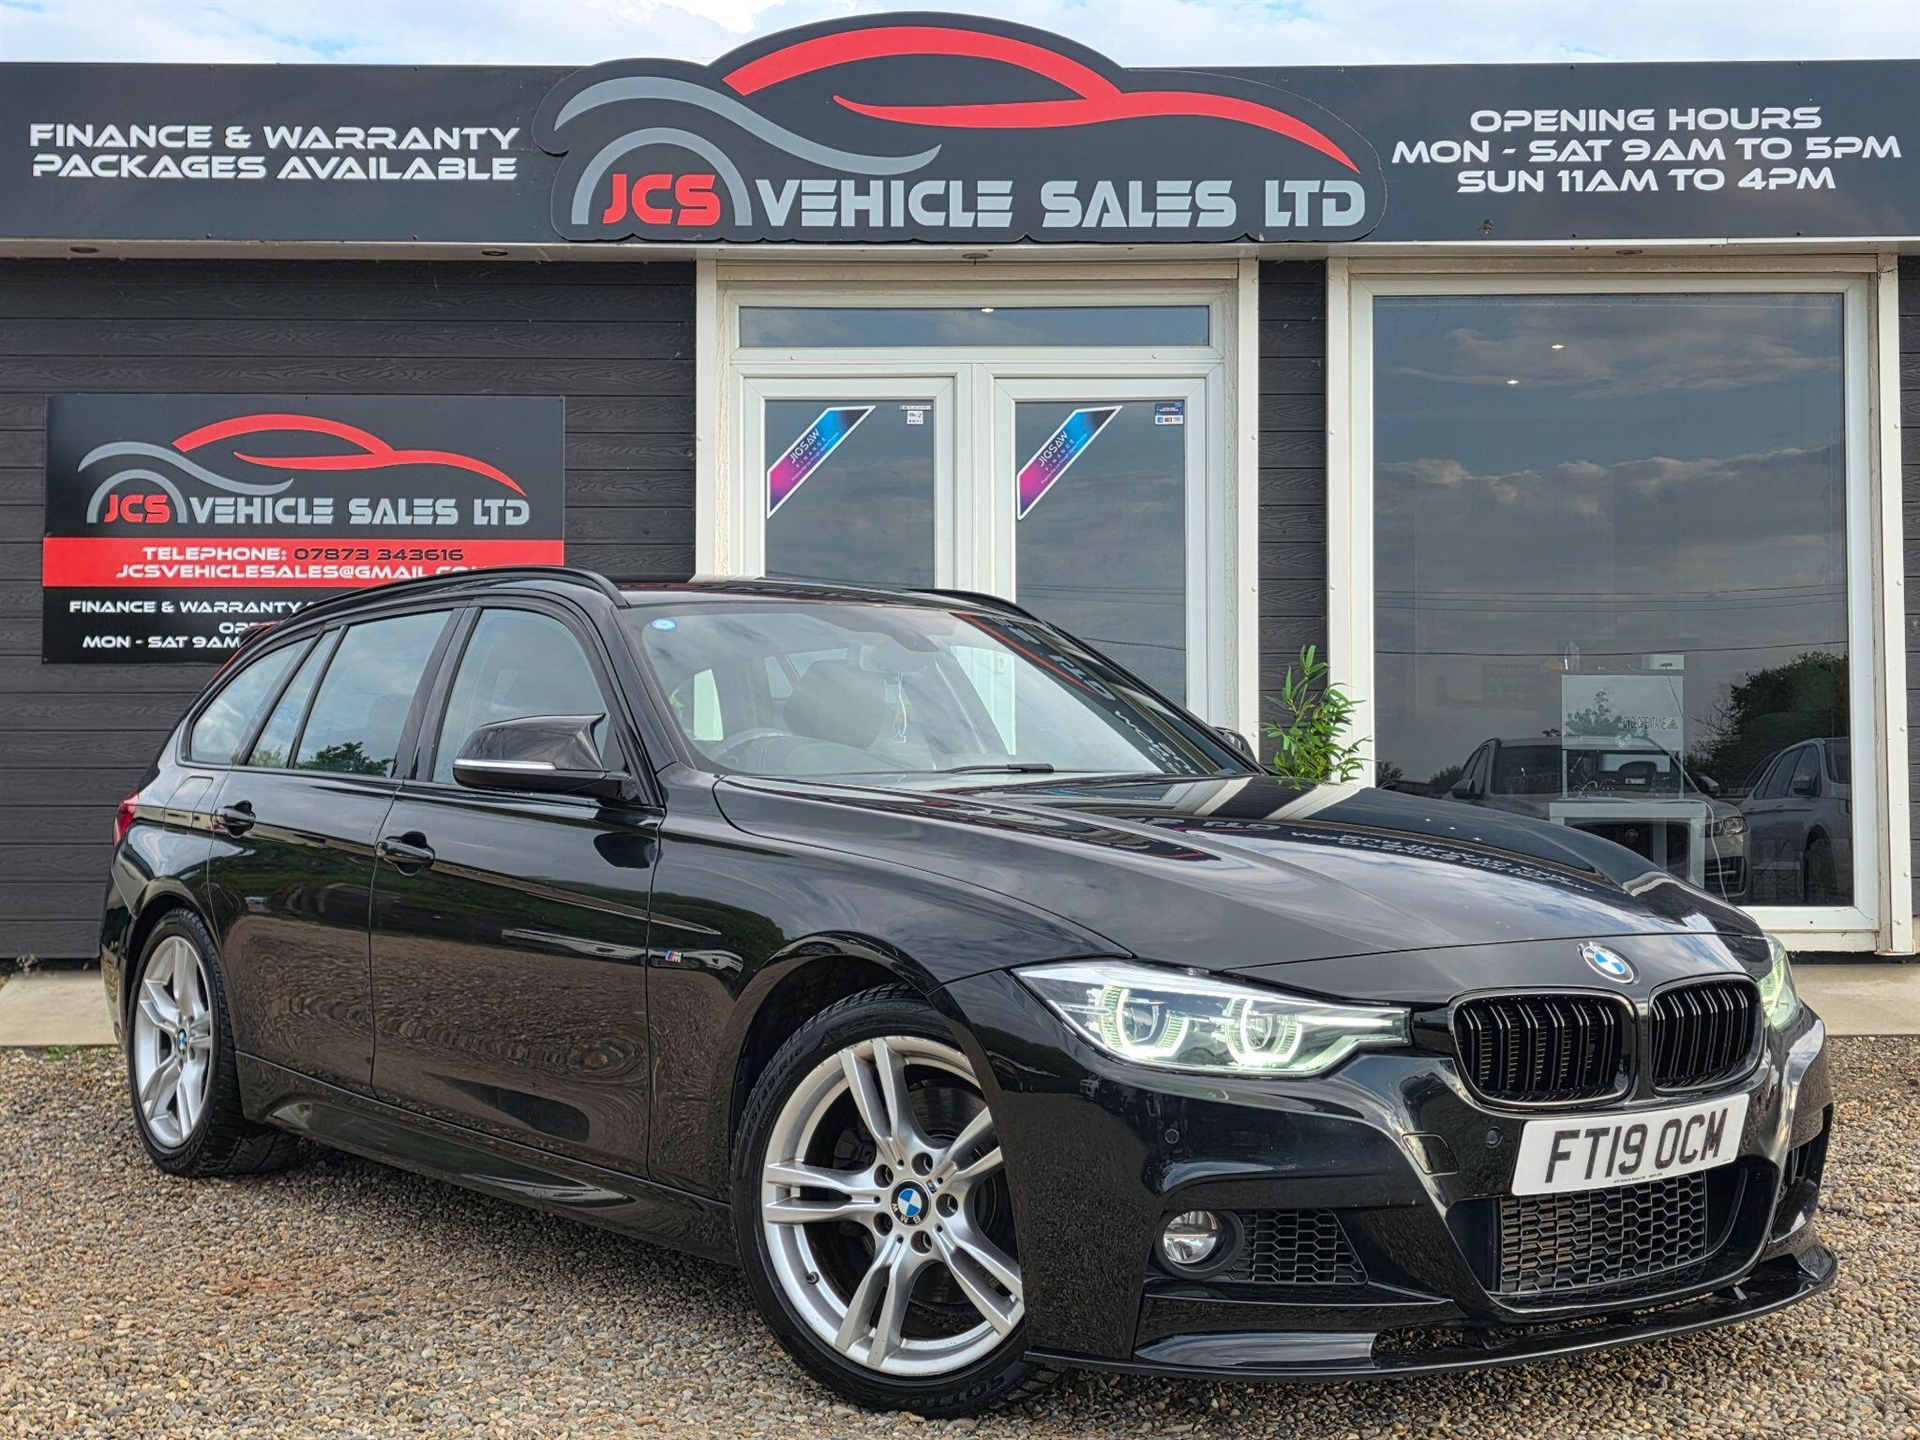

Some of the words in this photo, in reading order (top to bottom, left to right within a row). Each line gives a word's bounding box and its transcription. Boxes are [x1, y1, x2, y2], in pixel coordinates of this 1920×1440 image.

[1470, 108, 1655, 133] OPENING
[1668, 106, 1822, 131] HOURS
[30, 123, 213, 148] FINANCE
[224, 125, 252, 149] &
[262, 125, 520, 150] WARRANTY
[1391, 140, 1490, 164] MON
[1528, 139, 1613, 163] SAT
[1621, 137, 1726, 162] 9AM
[1734, 137, 1793, 161] TO
[1805, 135, 1902, 160] 5PM
[32, 153, 267, 179] PACKAGES
[276, 156, 518, 180] AVAILABLE
[1456, 169, 1544, 193] SUN
[1556, 168, 1659, 192] 11AM
[1667, 168, 1726, 191] TO
[1737, 166, 1837, 190] 4PM
[602, 173, 721, 226] JCS
[755, 179, 1013, 228] VEHICLE
[1040, 180, 1237, 228] SALES
[1264, 180, 1366, 227] LTD
[790, 428, 820, 464] JIGSAW
[1039, 430, 1068, 467] JIGSAW
[104, 494, 171, 524] JCS
[191, 496, 334, 525] VEHICLE
[348, 497, 459, 526] SALES
[473, 498, 530, 526] LTD
[142, 546, 287, 561] TELEPHONE:
[294, 548, 369, 560] 07873
[377, 548, 464, 561] 343616
[69, 601, 156, 613] FINANCE
[161, 601, 175, 613] &
[179, 601, 303, 614] WARRANTY
[82, 635, 130, 648] MON
[147, 636, 189, 648] SAT
[193, 636, 240, 649] 9AM
[1543, 1122, 1649, 1184] FT19
[1653, 1107, 1729, 1171] OCM
